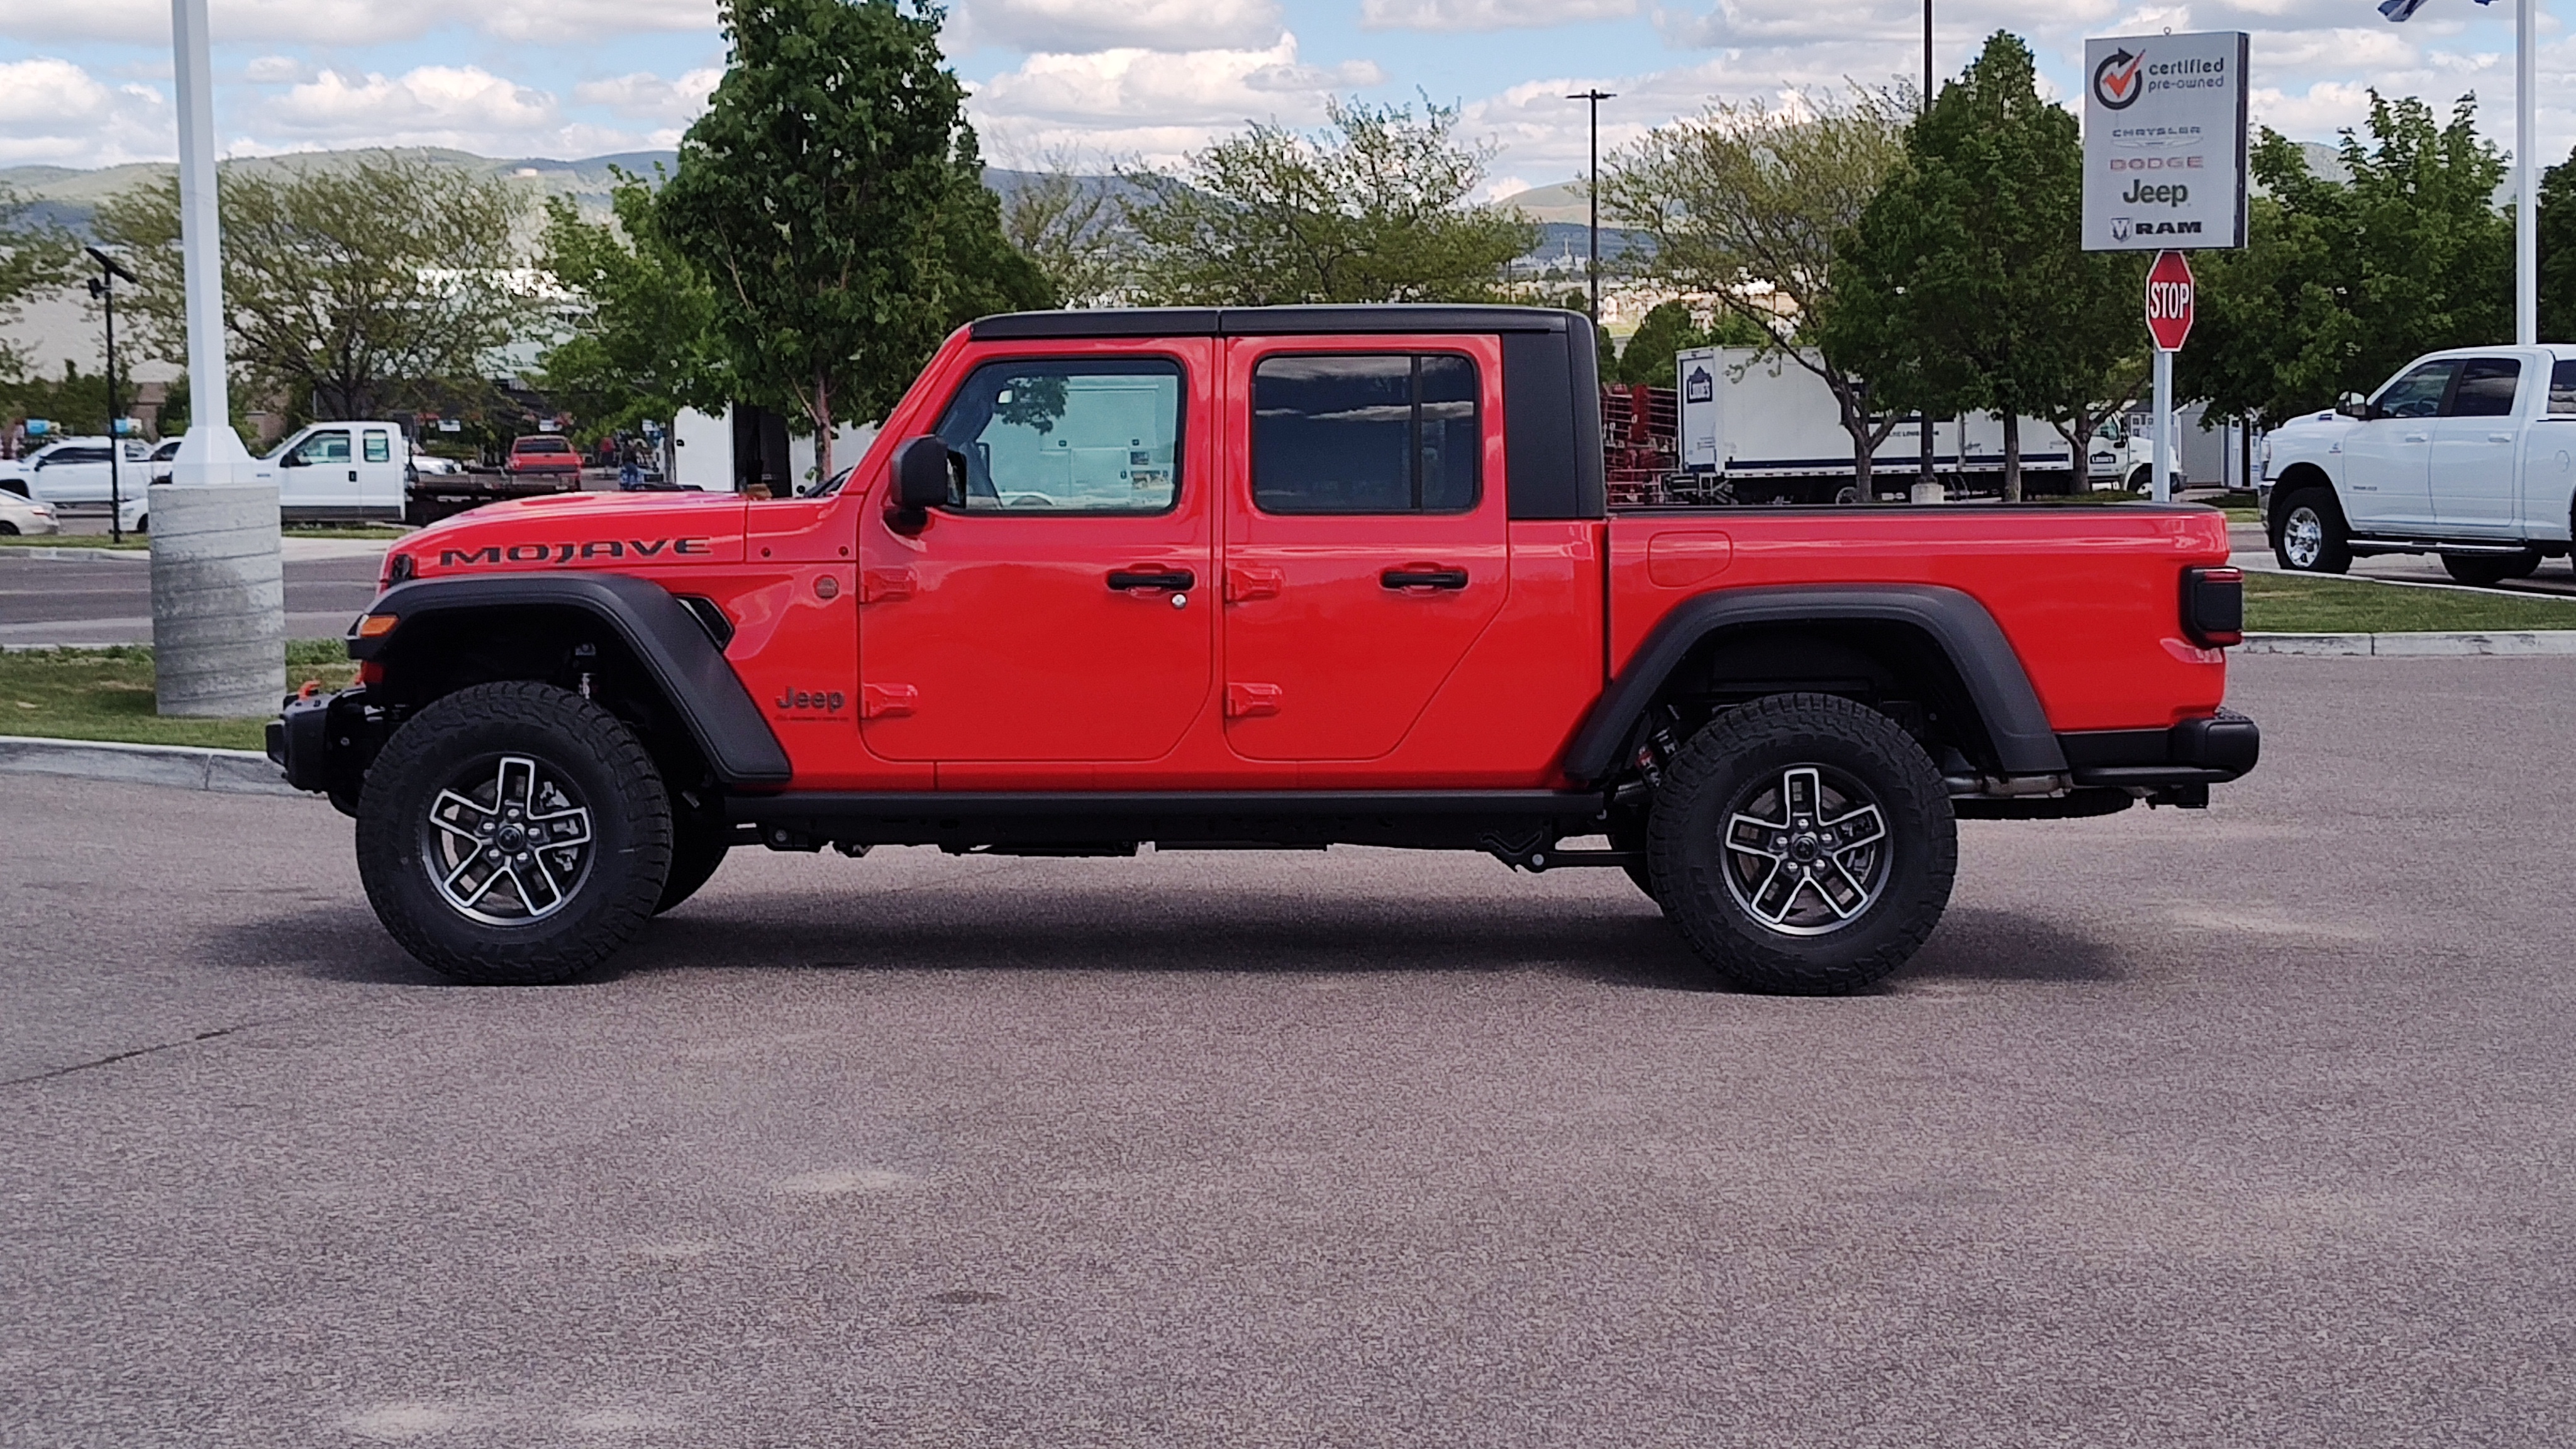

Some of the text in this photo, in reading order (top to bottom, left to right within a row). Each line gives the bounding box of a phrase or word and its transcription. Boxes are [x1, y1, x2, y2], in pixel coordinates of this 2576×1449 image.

[2149, 57, 2224, 75] certified
[2148, 75, 2224, 93] pre-owned
[2112, 126, 2200, 136] CHRYSLER
[2111, 156, 2204, 170] DODGE
[2123, 179, 2189, 208] Jeep
[2136, 221, 2202, 234] RAM
[2150, 282, 2189, 319] STOP
[440, 536, 711, 566] MOJAVE
[775, 687, 845, 713] Jeep
